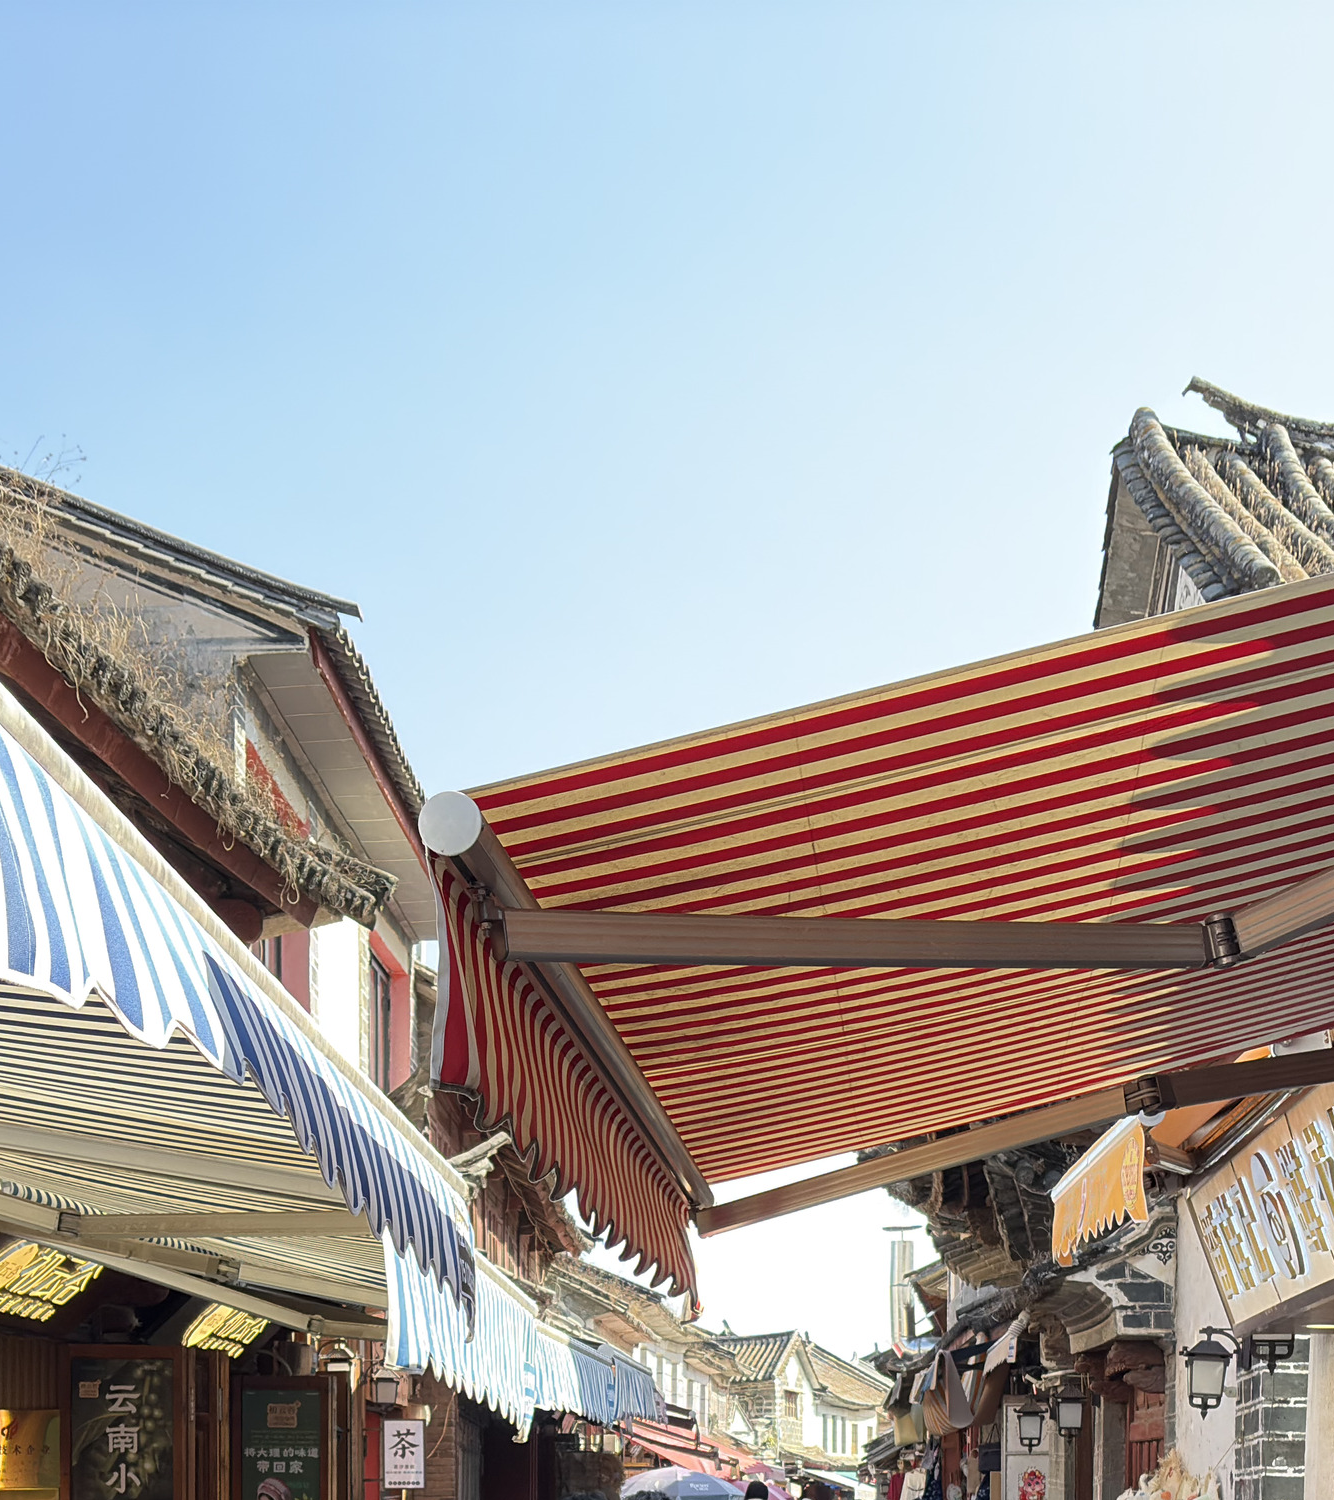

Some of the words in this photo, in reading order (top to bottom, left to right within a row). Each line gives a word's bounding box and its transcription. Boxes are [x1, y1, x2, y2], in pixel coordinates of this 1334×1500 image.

[388, 1428, 420, 1460] 茶
[244, 1447, 319, 1458] 将大理的味道
[256, 1460, 304, 1474] 带回家
